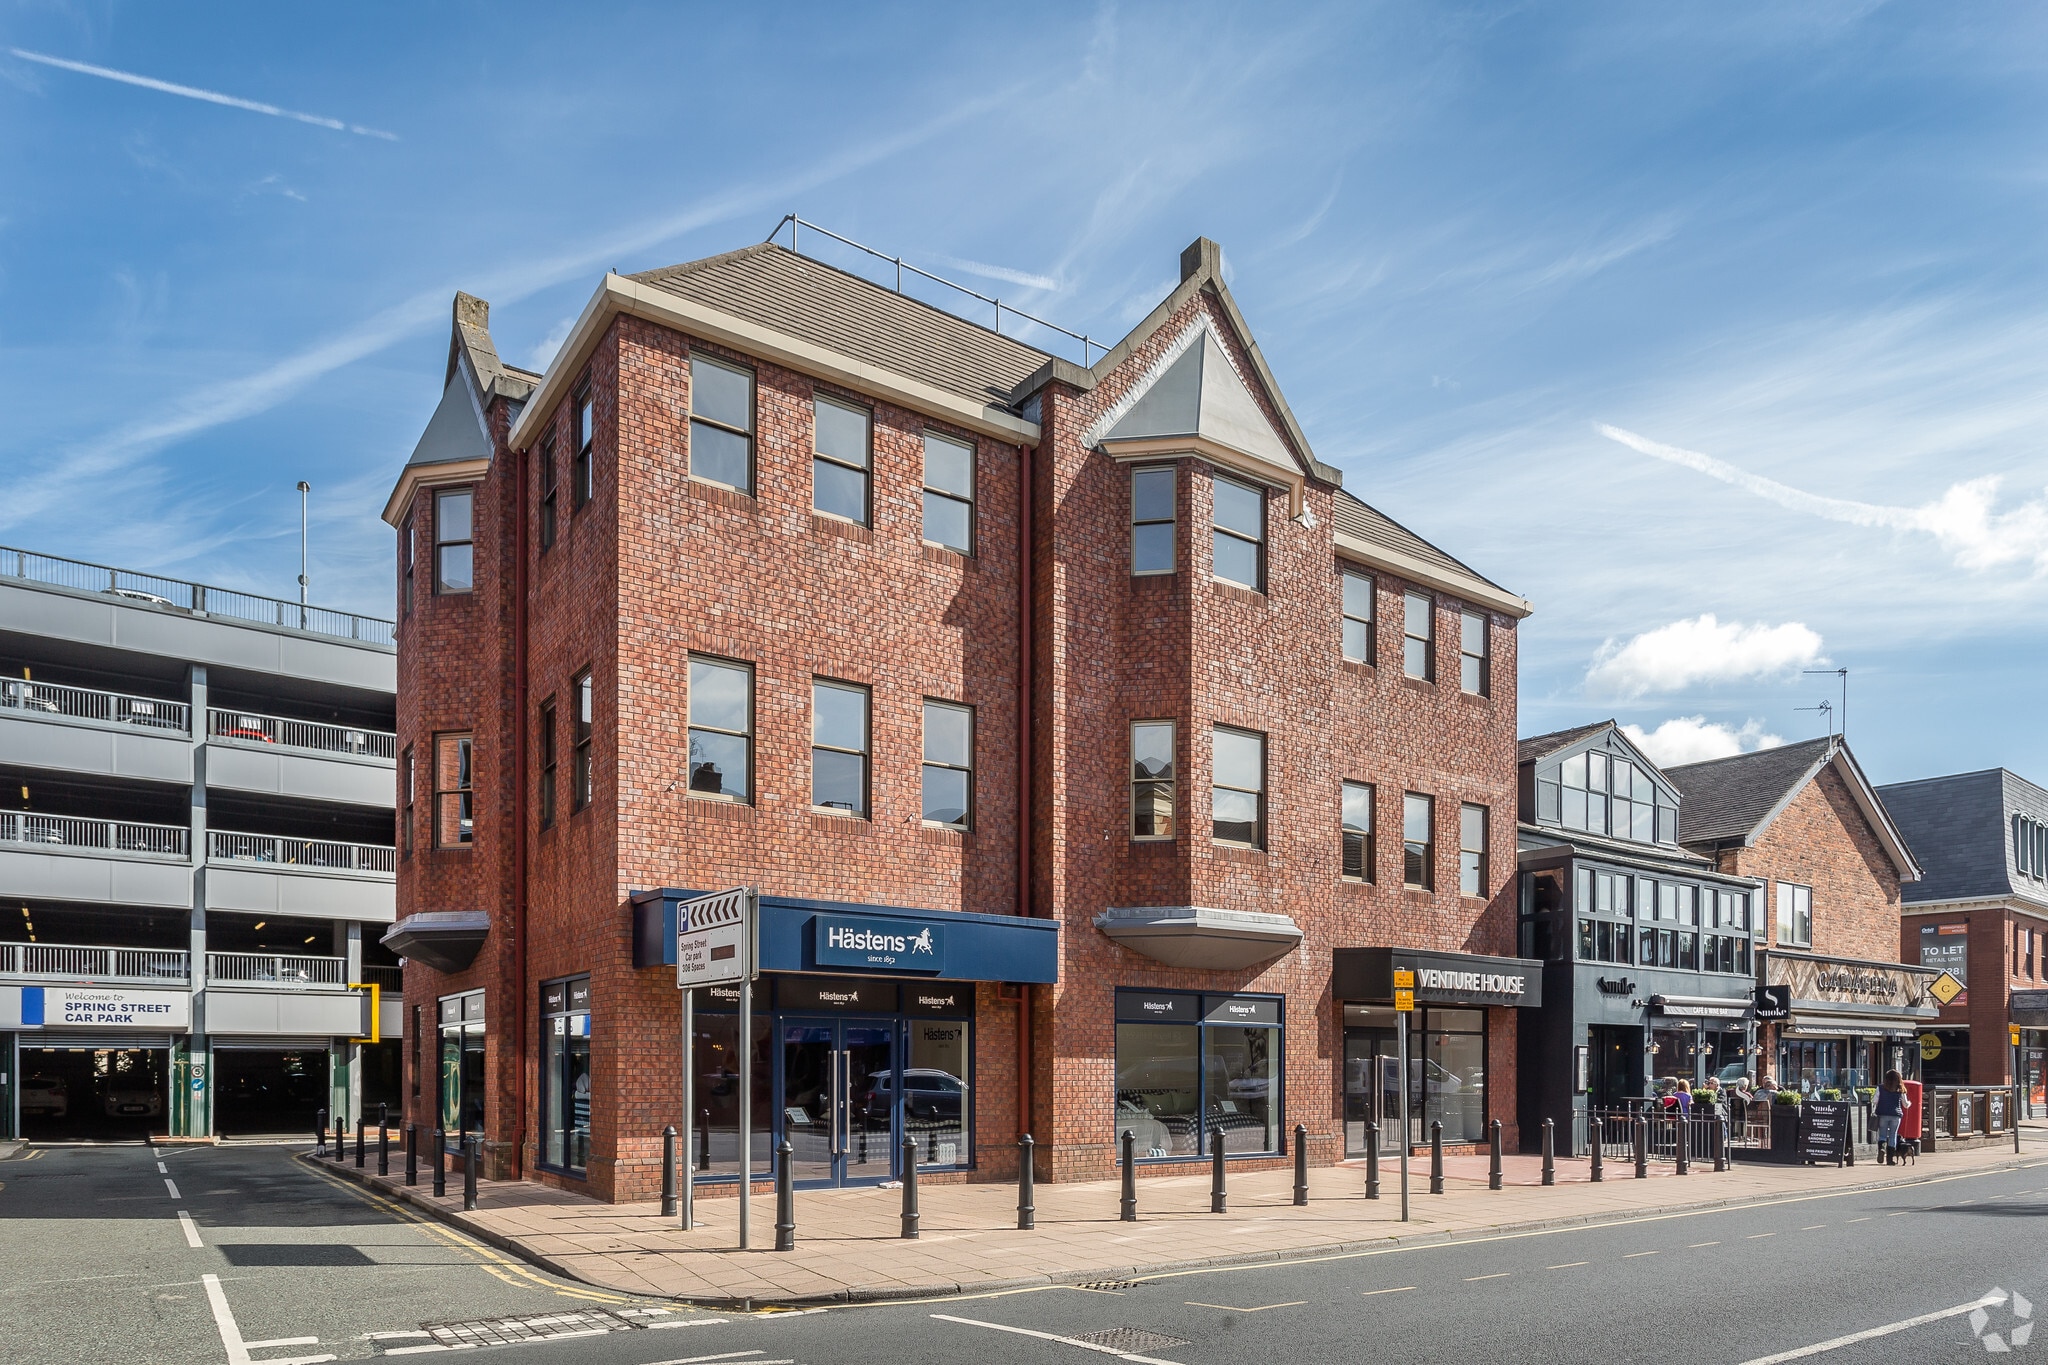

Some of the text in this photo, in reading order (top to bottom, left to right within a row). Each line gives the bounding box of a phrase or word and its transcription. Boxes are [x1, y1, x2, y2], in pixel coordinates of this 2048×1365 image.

[680, 907, 687, 931] P
[828, 926, 906, 952] Hästens
[681, 938, 707, 952] Spring Street
[1922, 945, 1964, 956] TO LET
[692, 950, 702, 961] park
[867, 954, 896, 965] since 1852
[691, 961, 706, 972] Spaces
[1417, 968, 1480, 991] VENTURE
[1481, 973, 1525, 994] HOUSE
[1596, 976, 1637, 995] Smoke
[710, 987, 741, 997] Hästens
[1941, 984, 1950, 993] C
[64, 992, 125, 1001] Welcome to
[819, 990, 849, 1001] Hästens
[918, 995, 946, 1005] Hästens
[64, 1002, 172, 1013] SPRING STREET
[1756, 1007, 1787, 1017] Smoke
[64, 1013, 133, 1023] CAR PARK
[923, 1027, 954, 1041] Hästens
[1924, 1039, 1934, 1047] 70
[194, 1068, 200, 1076] 5
